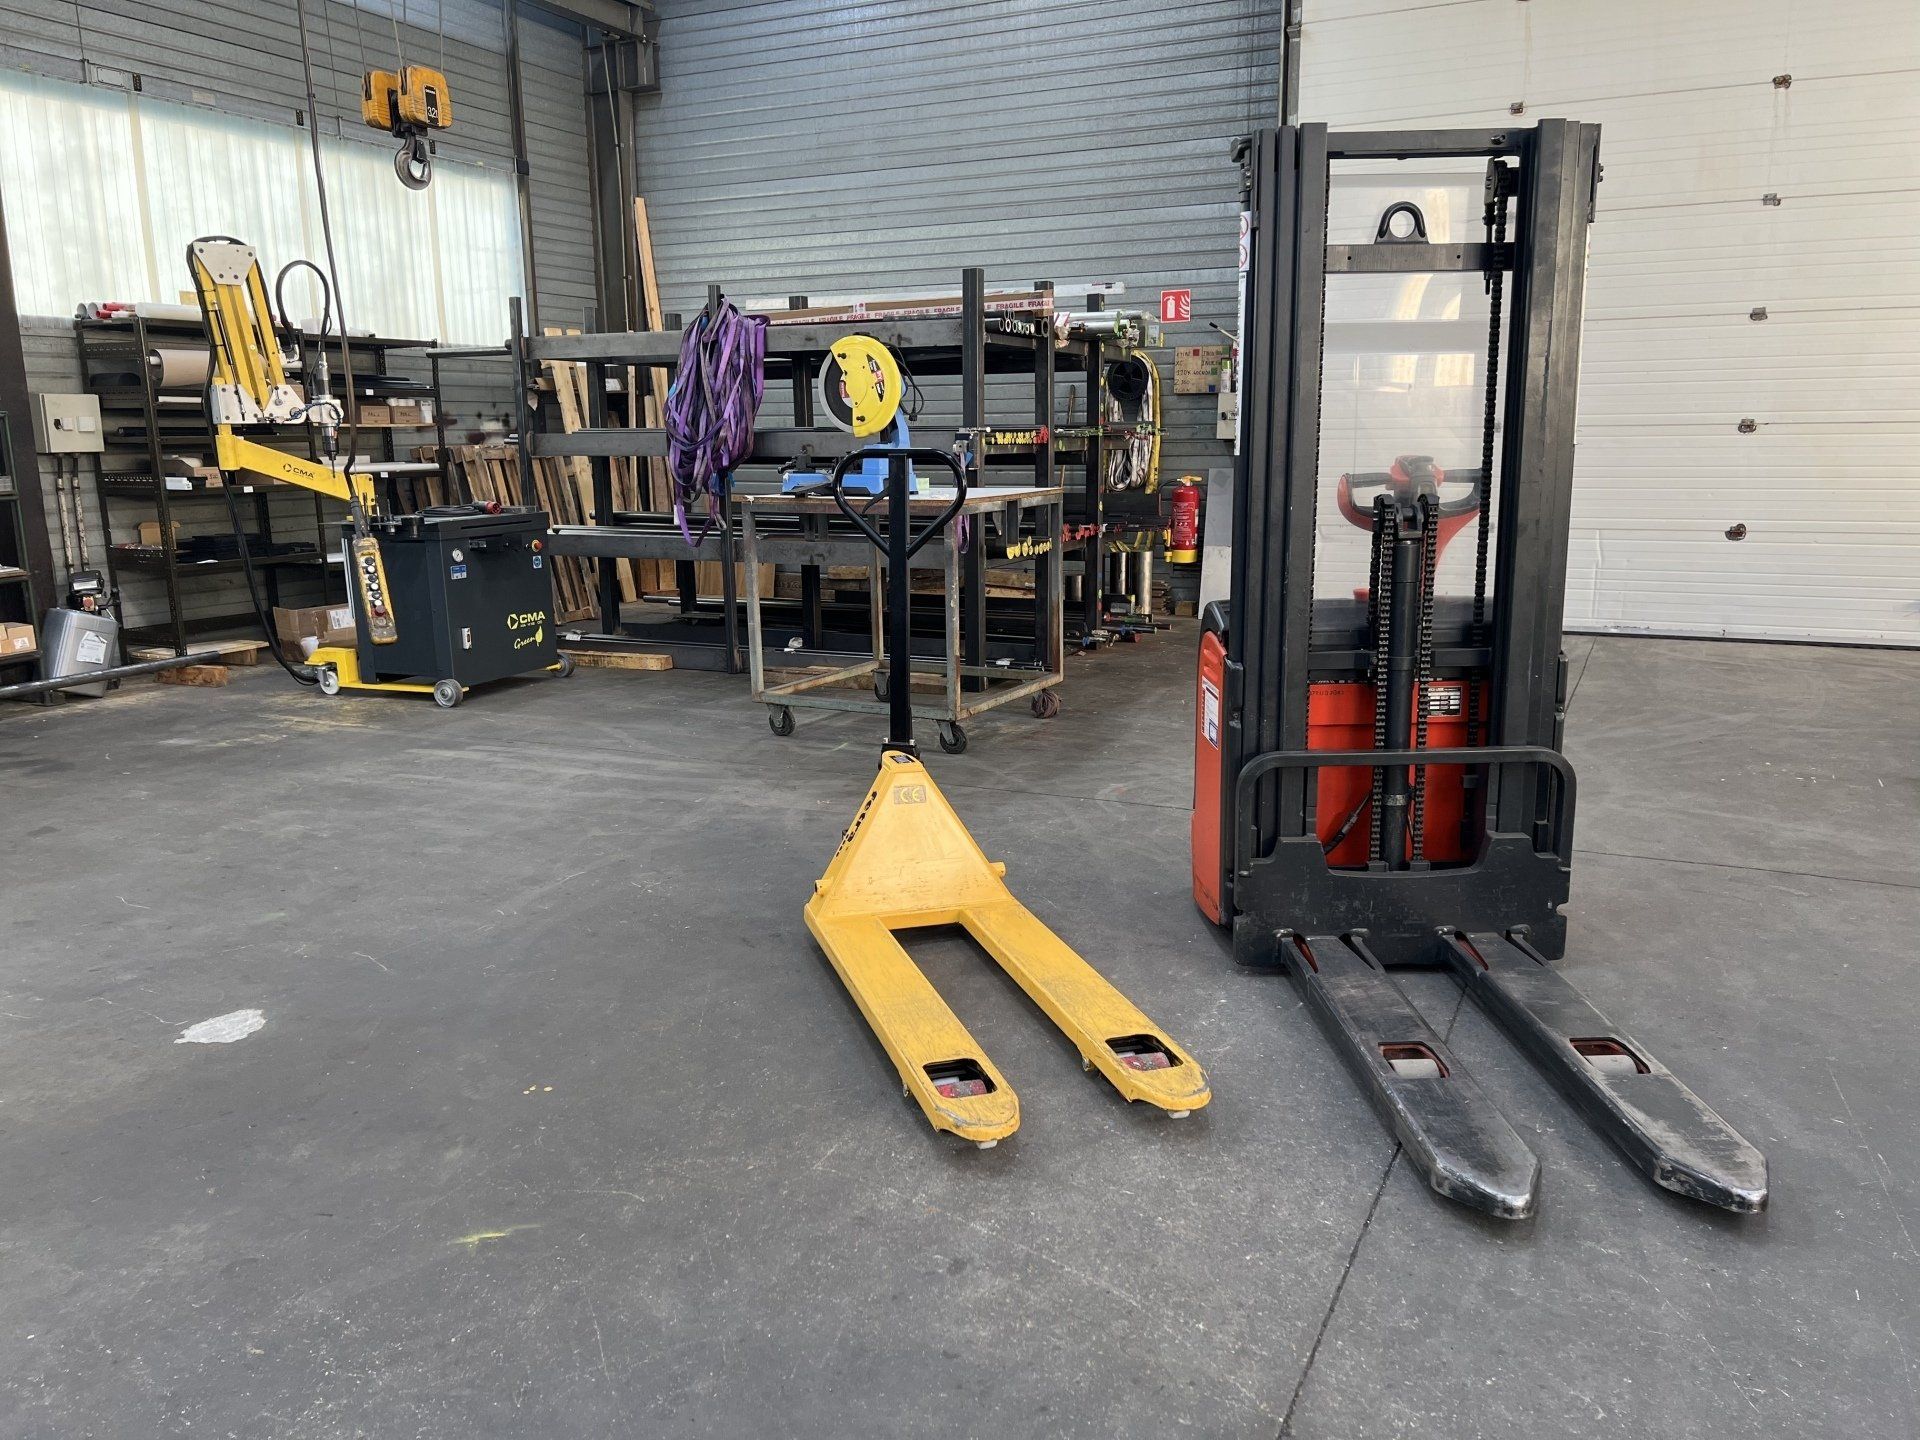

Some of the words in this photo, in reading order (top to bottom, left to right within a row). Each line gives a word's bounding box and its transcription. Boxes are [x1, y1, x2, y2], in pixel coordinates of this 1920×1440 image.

[846, 312, 871, 321] FRAGILE
[933, 306, 961, 315] FRAGILE
[995, 301, 1024, 310] FRAGILE
[293, 467, 314, 479] CMA
[519, 611, 546, 624] CMA
[900, 787, 922, 803] CE
